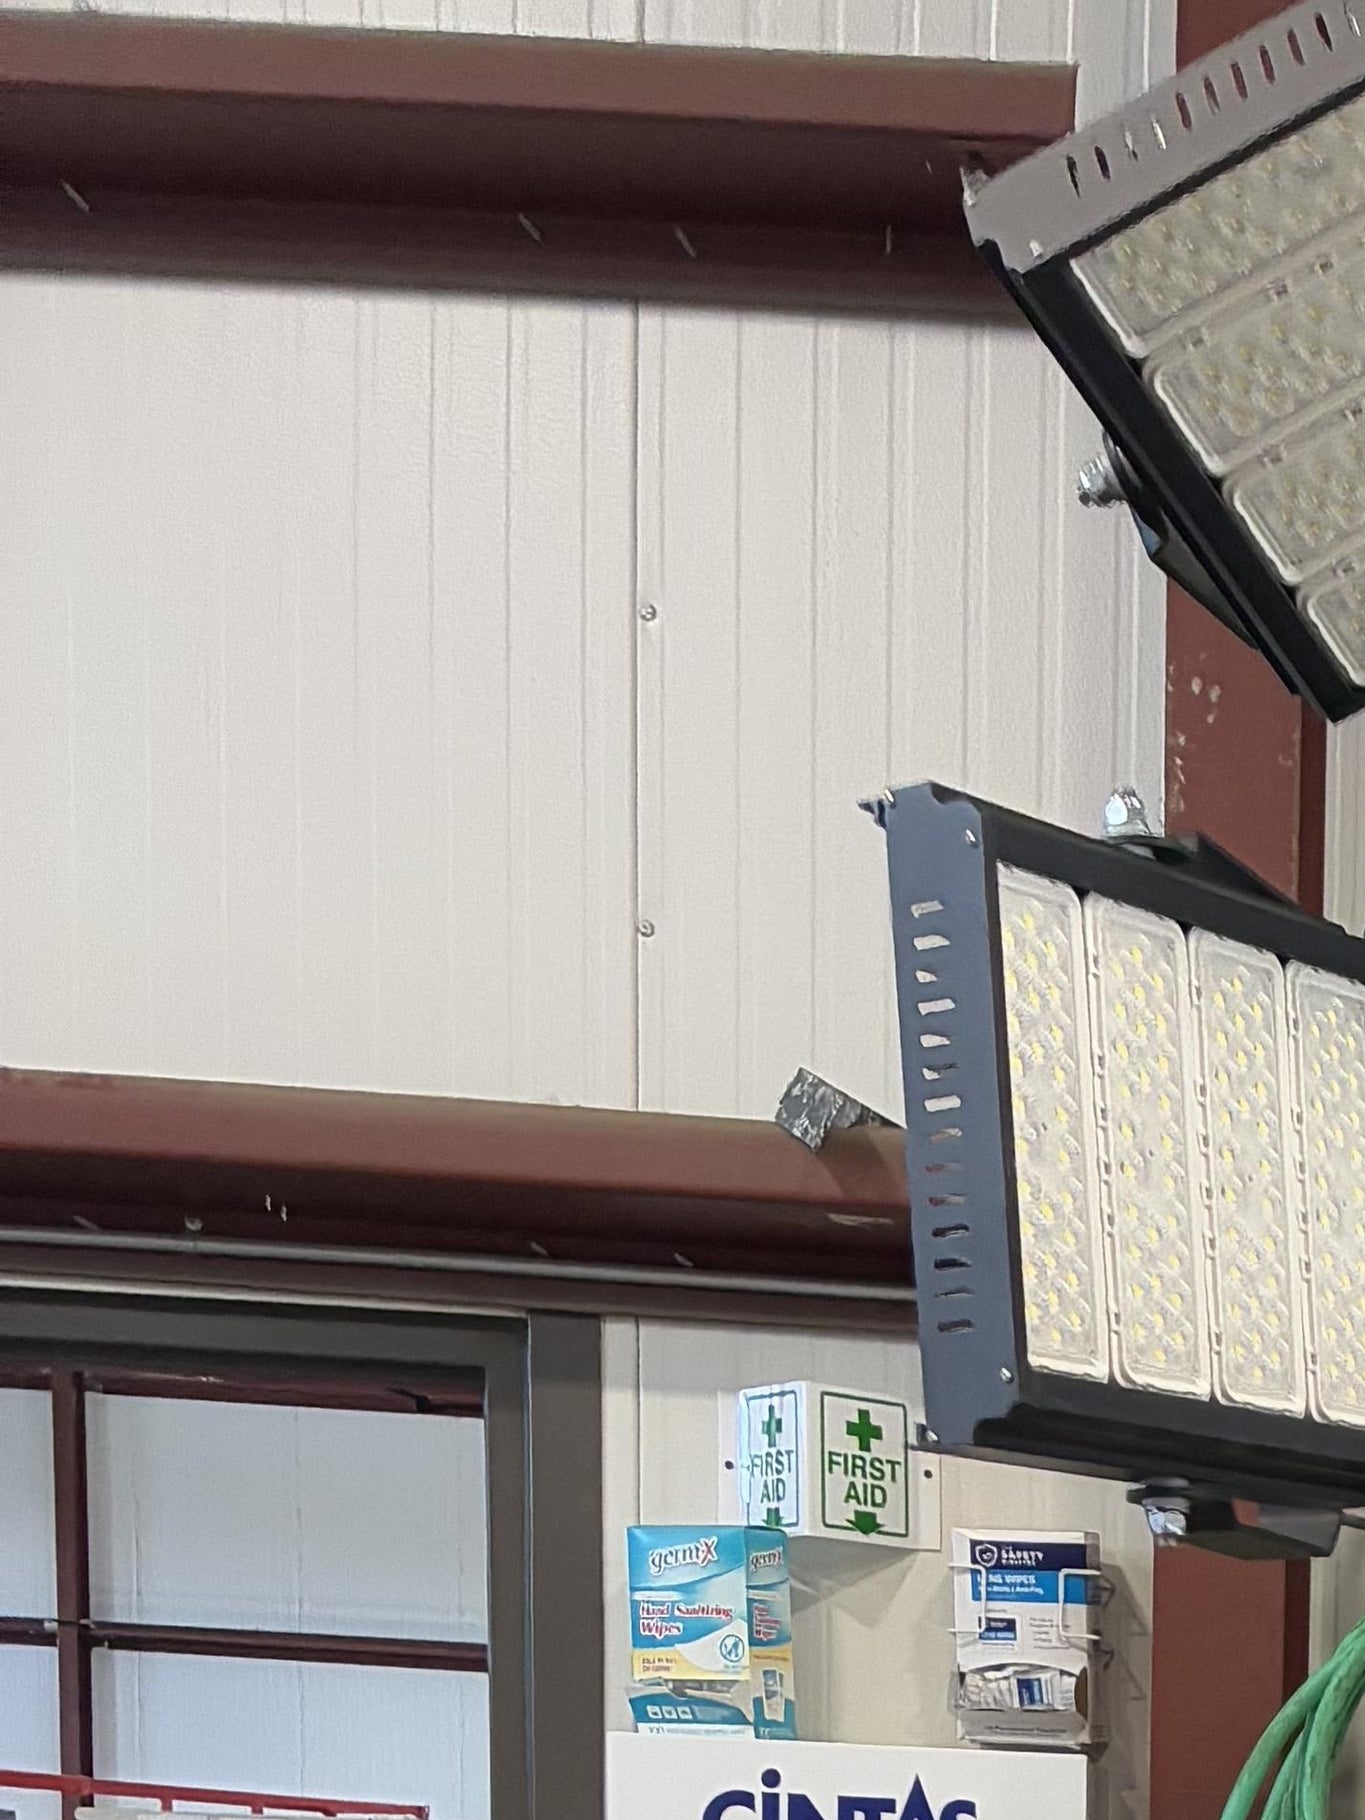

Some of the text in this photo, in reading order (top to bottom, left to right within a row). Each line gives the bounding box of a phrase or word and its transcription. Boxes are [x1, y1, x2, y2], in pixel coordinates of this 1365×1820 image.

[750, 1449, 794, 1478] FIRST
[828, 1452, 901, 1483] FIRST
[761, 1479, 786, 1504] AID
[844, 1481, 887, 1509] AID
[675, 1605, 734, 1620] Sanitizing
[640, 1619, 681, 1639] Wipes
